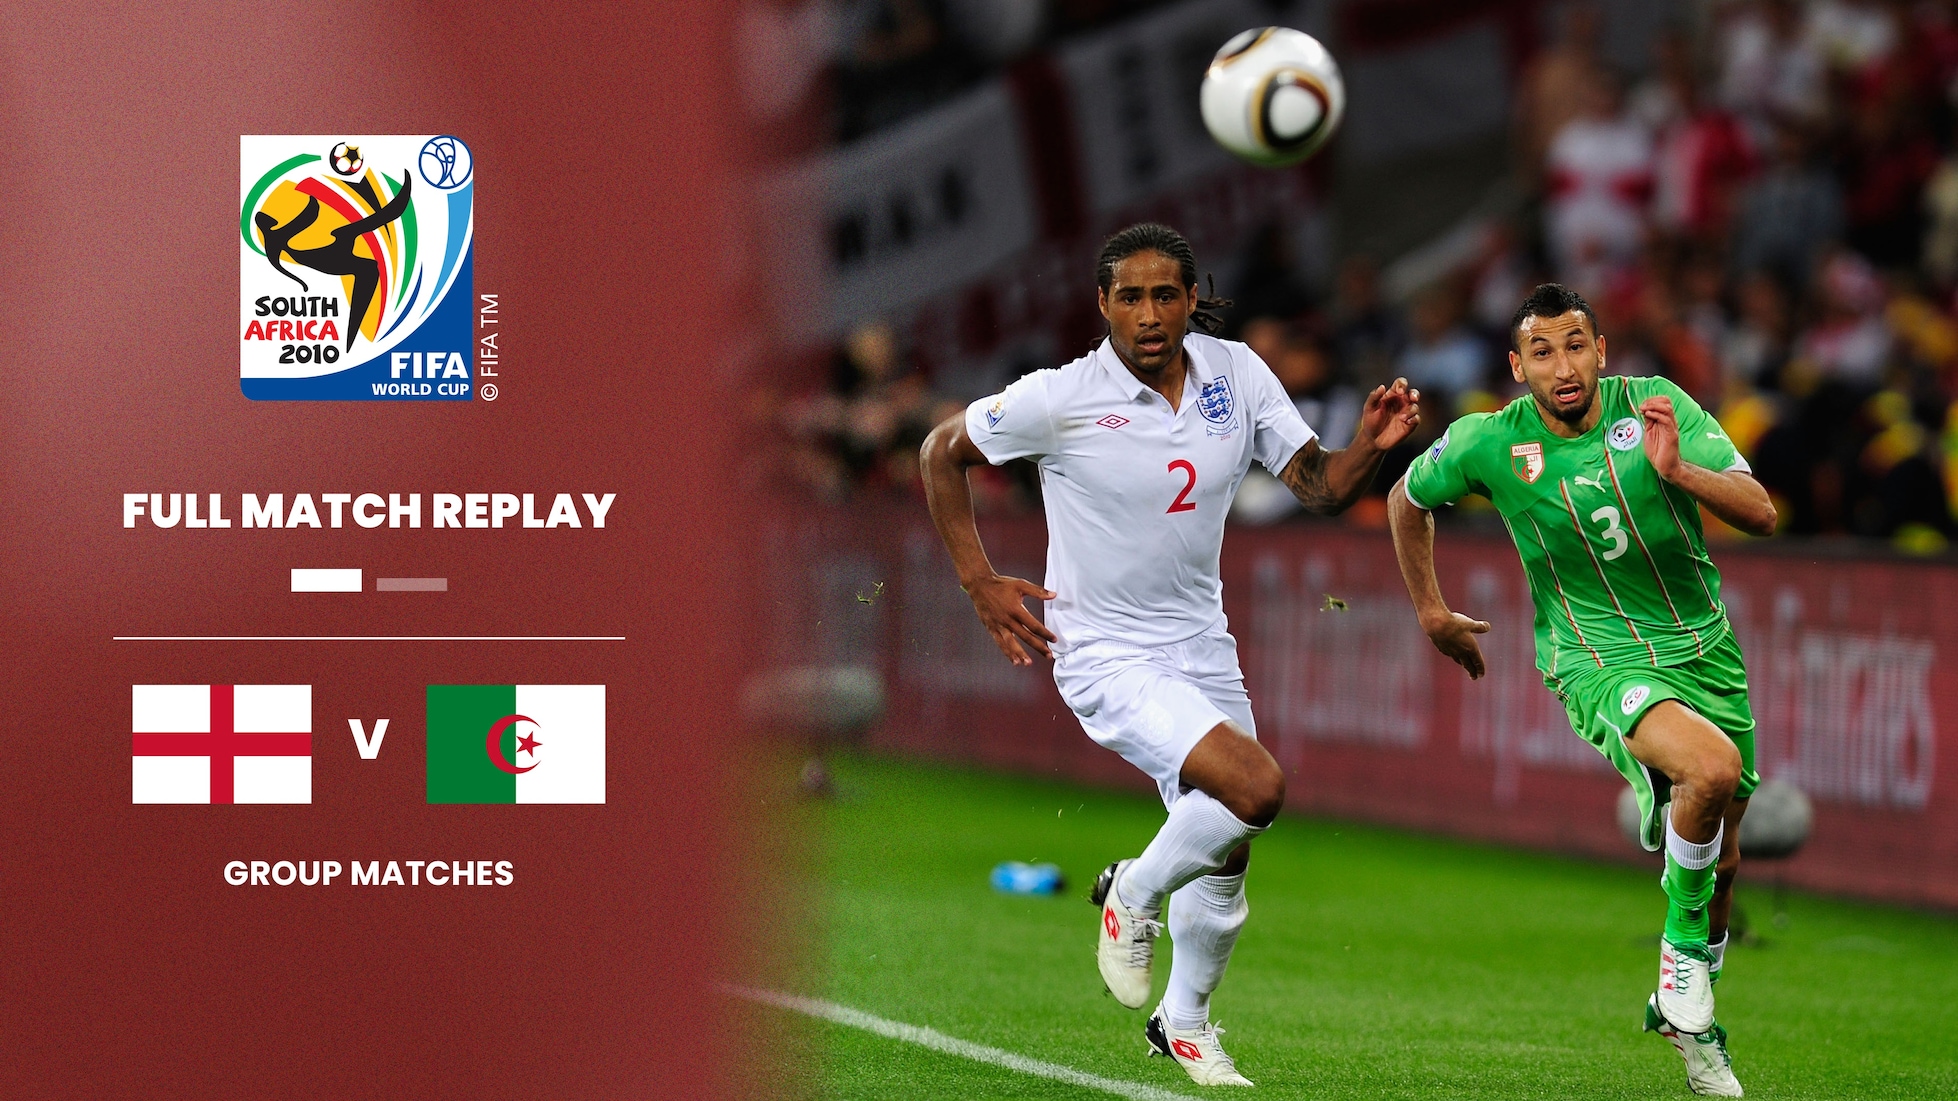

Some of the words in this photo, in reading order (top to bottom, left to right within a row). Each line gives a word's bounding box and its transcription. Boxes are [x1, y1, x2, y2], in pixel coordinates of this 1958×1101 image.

[1513, 445, 1539, 454] ALGERIA
[1166, 459, 1197, 514] 2
[1590, 505, 1629, 561] 3
